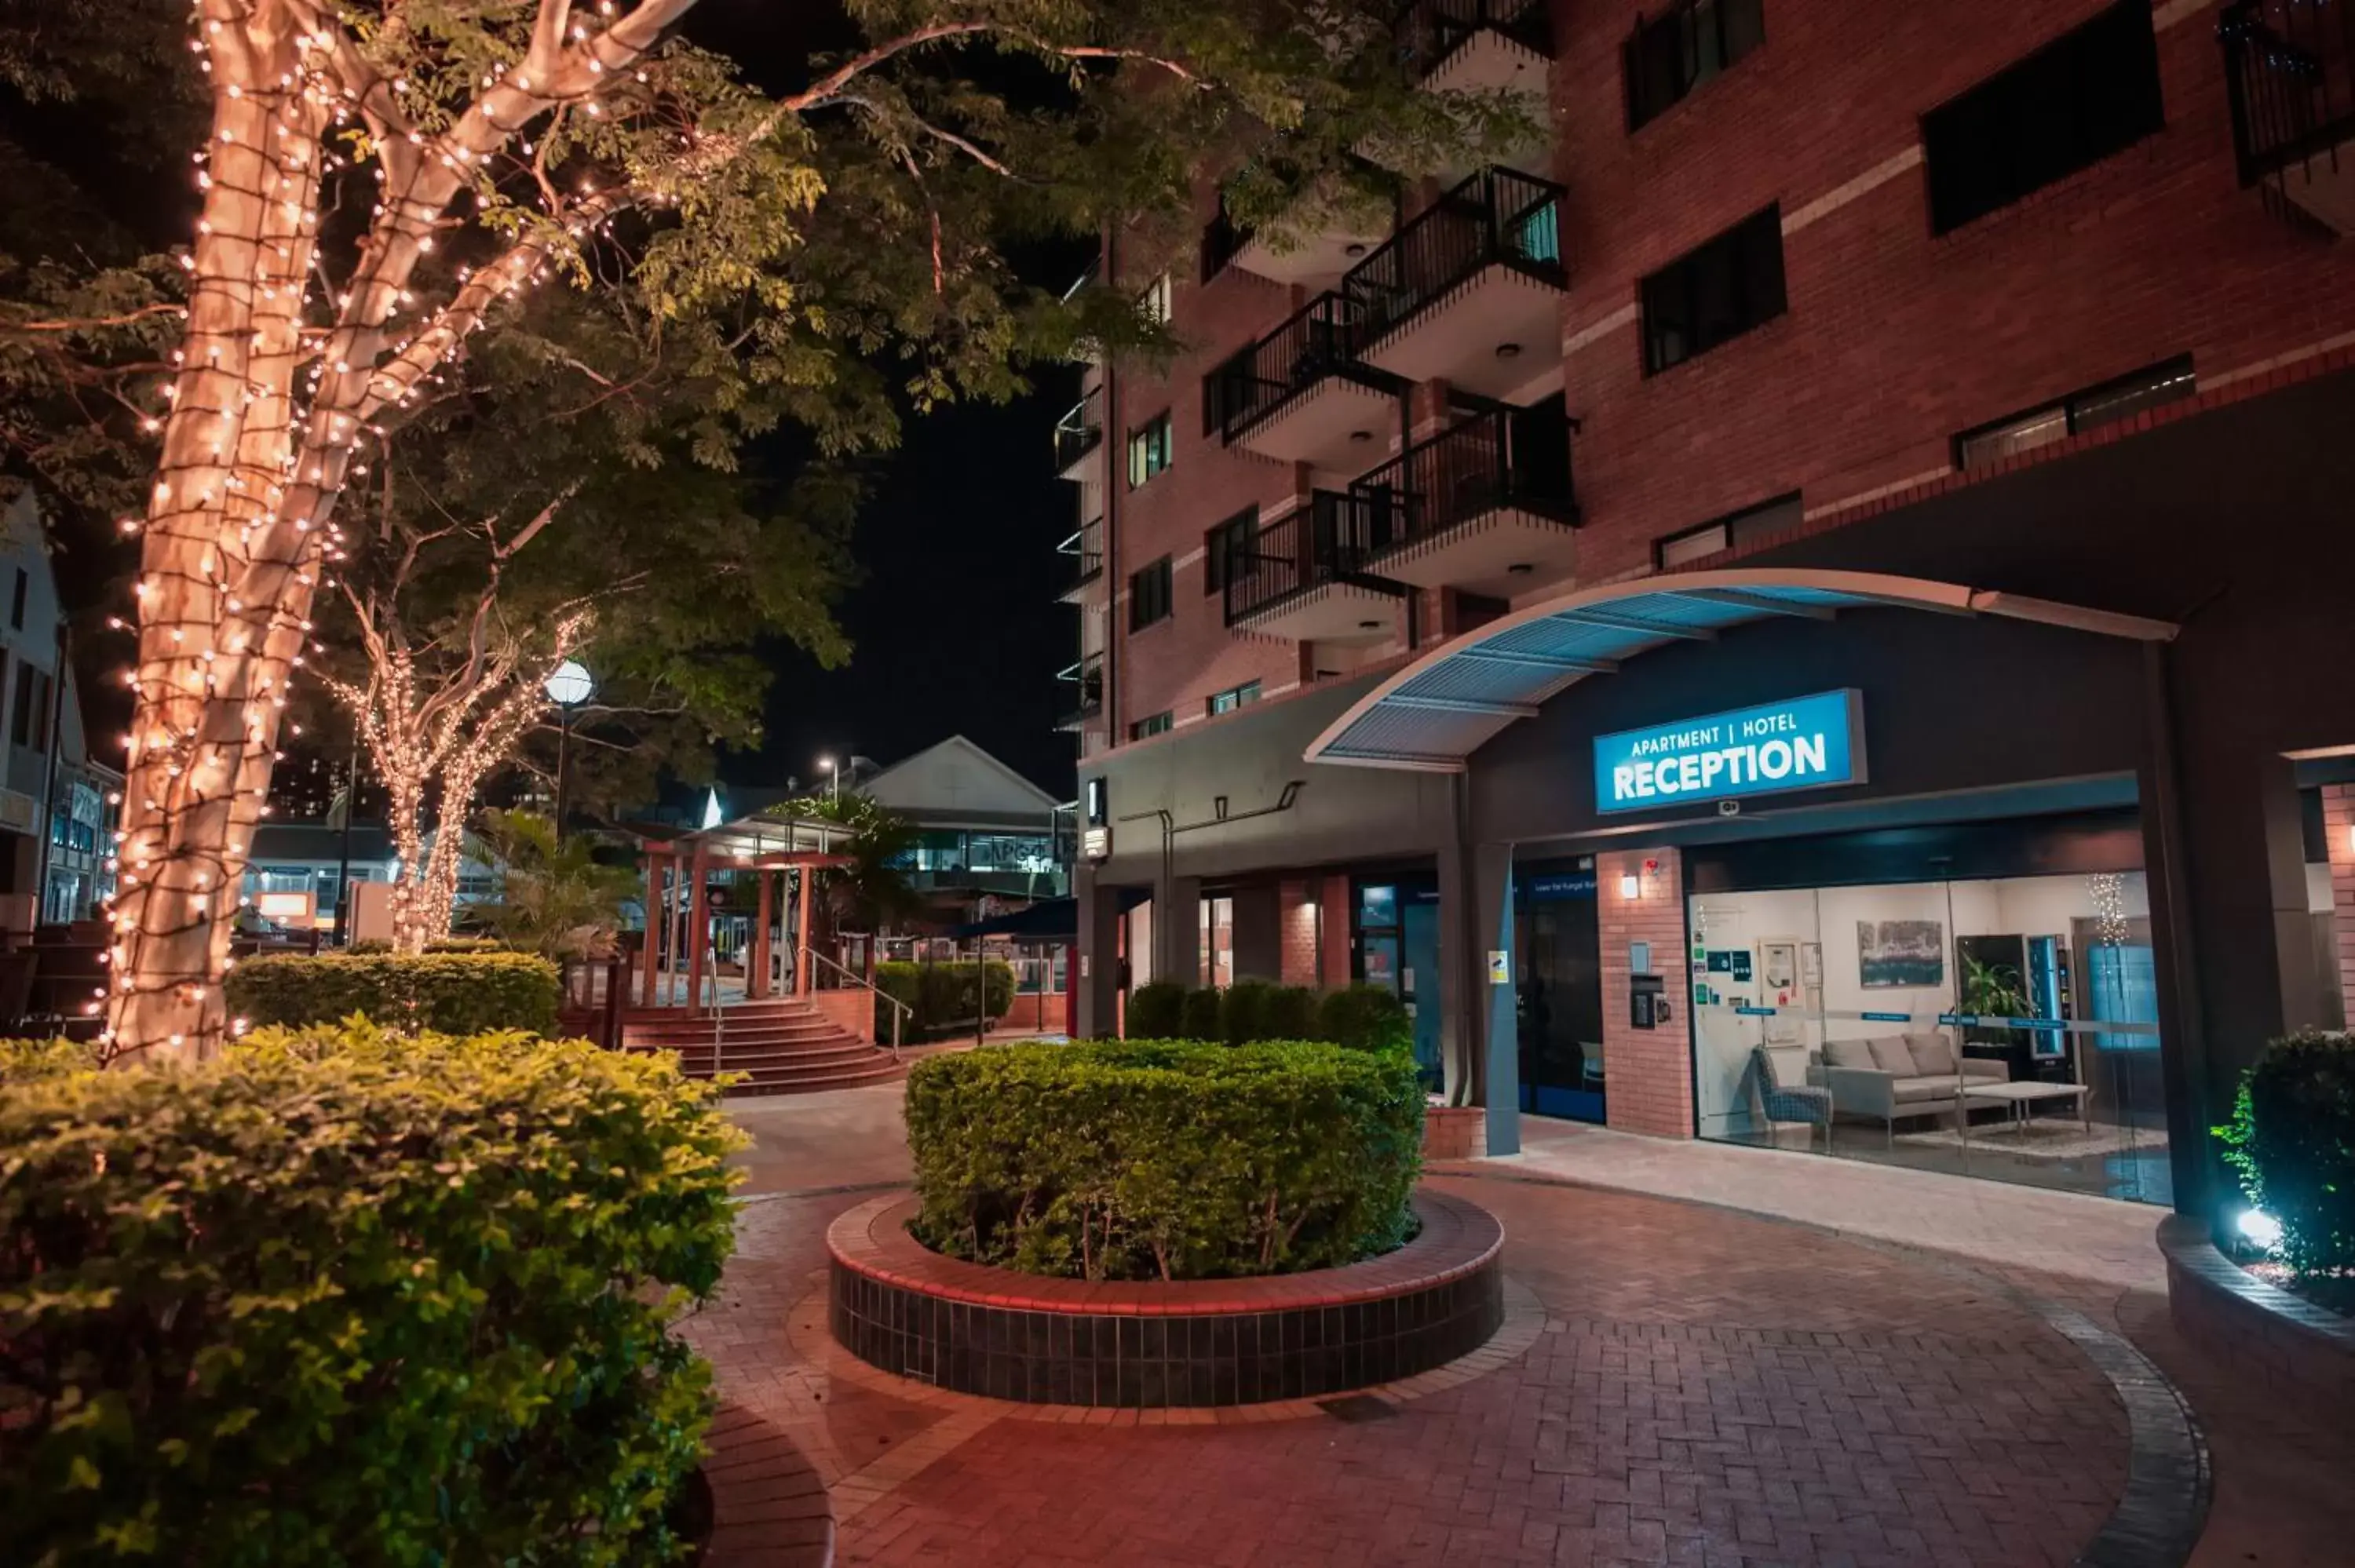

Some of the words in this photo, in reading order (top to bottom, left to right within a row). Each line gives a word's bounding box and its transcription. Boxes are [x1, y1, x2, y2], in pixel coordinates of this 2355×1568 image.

[1631, 726, 1719, 757] APARTMENT
[1743, 713, 1796, 738] HOTEL
[1613, 733, 1826, 800] RECEPTION
